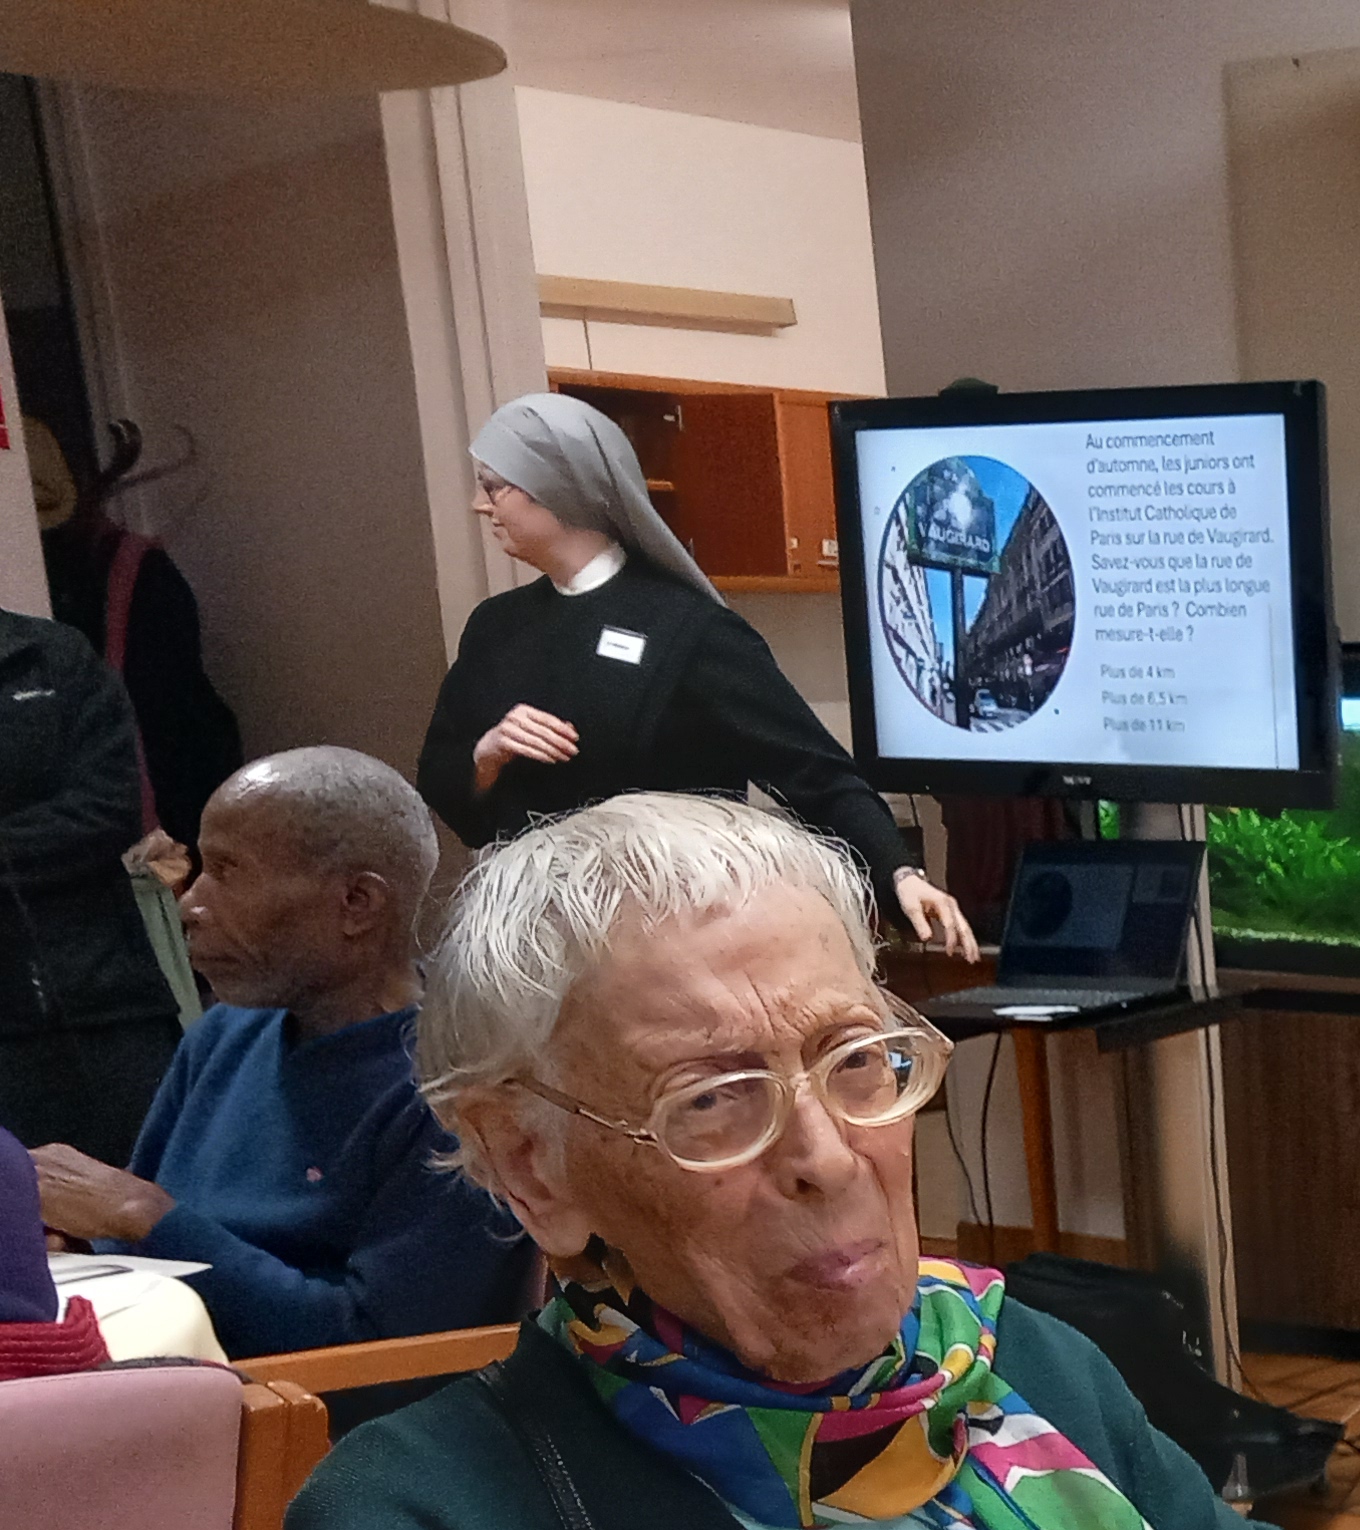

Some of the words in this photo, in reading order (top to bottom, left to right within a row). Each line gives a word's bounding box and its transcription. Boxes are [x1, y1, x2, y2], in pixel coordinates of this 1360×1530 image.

[1085, 433, 1103, 450] Au
[1105, 431, 1215, 450] commencement
[1086, 457, 1159, 474] d'automne,
[1161, 455, 1182, 472] les
[1184, 454, 1230, 475] juniors
[1232, 454, 1255, 469] ont
[1088, 480, 1161, 498] commencé
[1164, 480, 1184, 496] les
[1187, 481, 1225, 496] cours
[1227, 478, 1236, 495] à
[1088, 506, 1143, 522] l'Institut
[1144, 504, 1217, 523] Catholique
[1219, 503, 1237, 520] de
[1090, 529, 1122, 546] Paris
[1125, 532, 1147, 546] sur
[1148, 529, 1161, 544] la
[1163, 532, 1185, 545] rue
[1187, 529, 1205, 544] de
[1206, 527, 1275, 548] Vaugirard.
[1091, 553, 1166, 571] Savez-vous
[1167, 555, 1193, 572] que
[1195, 553, 1208, 569] la
[1211, 555, 1233, 569] rue
[1235, 553, 1253, 569] de
[1091, 578, 1152, 598] Vaugirard
[1155, 578, 1176, 593] est
[1178, 577, 1191, 593] la
[1193, 577, 1223, 596] plus
[1225, 577, 1271, 597] longue
[1094, 604, 1115, 618] rue
[1117, 602, 1134, 618] de
[1136, 601, 1169, 618] Paris
[1185, 600, 1247, 618] Combien
[1095, 625, 1184, 642] mesure-t-elle
[1100, 663, 1126, 679] Plus
[1128, 666, 1144, 679] de
[1155, 666, 1176, 679] km
[1101, 690, 1127, 705] Plus
[1129, 692, 1146, 705] de
[1168, 693, 1188, 705] km
[1103, 716, 1130, 732] Plus
[1131, 719, 1147, 732] de
[1165, 719, 1186, 733] km
